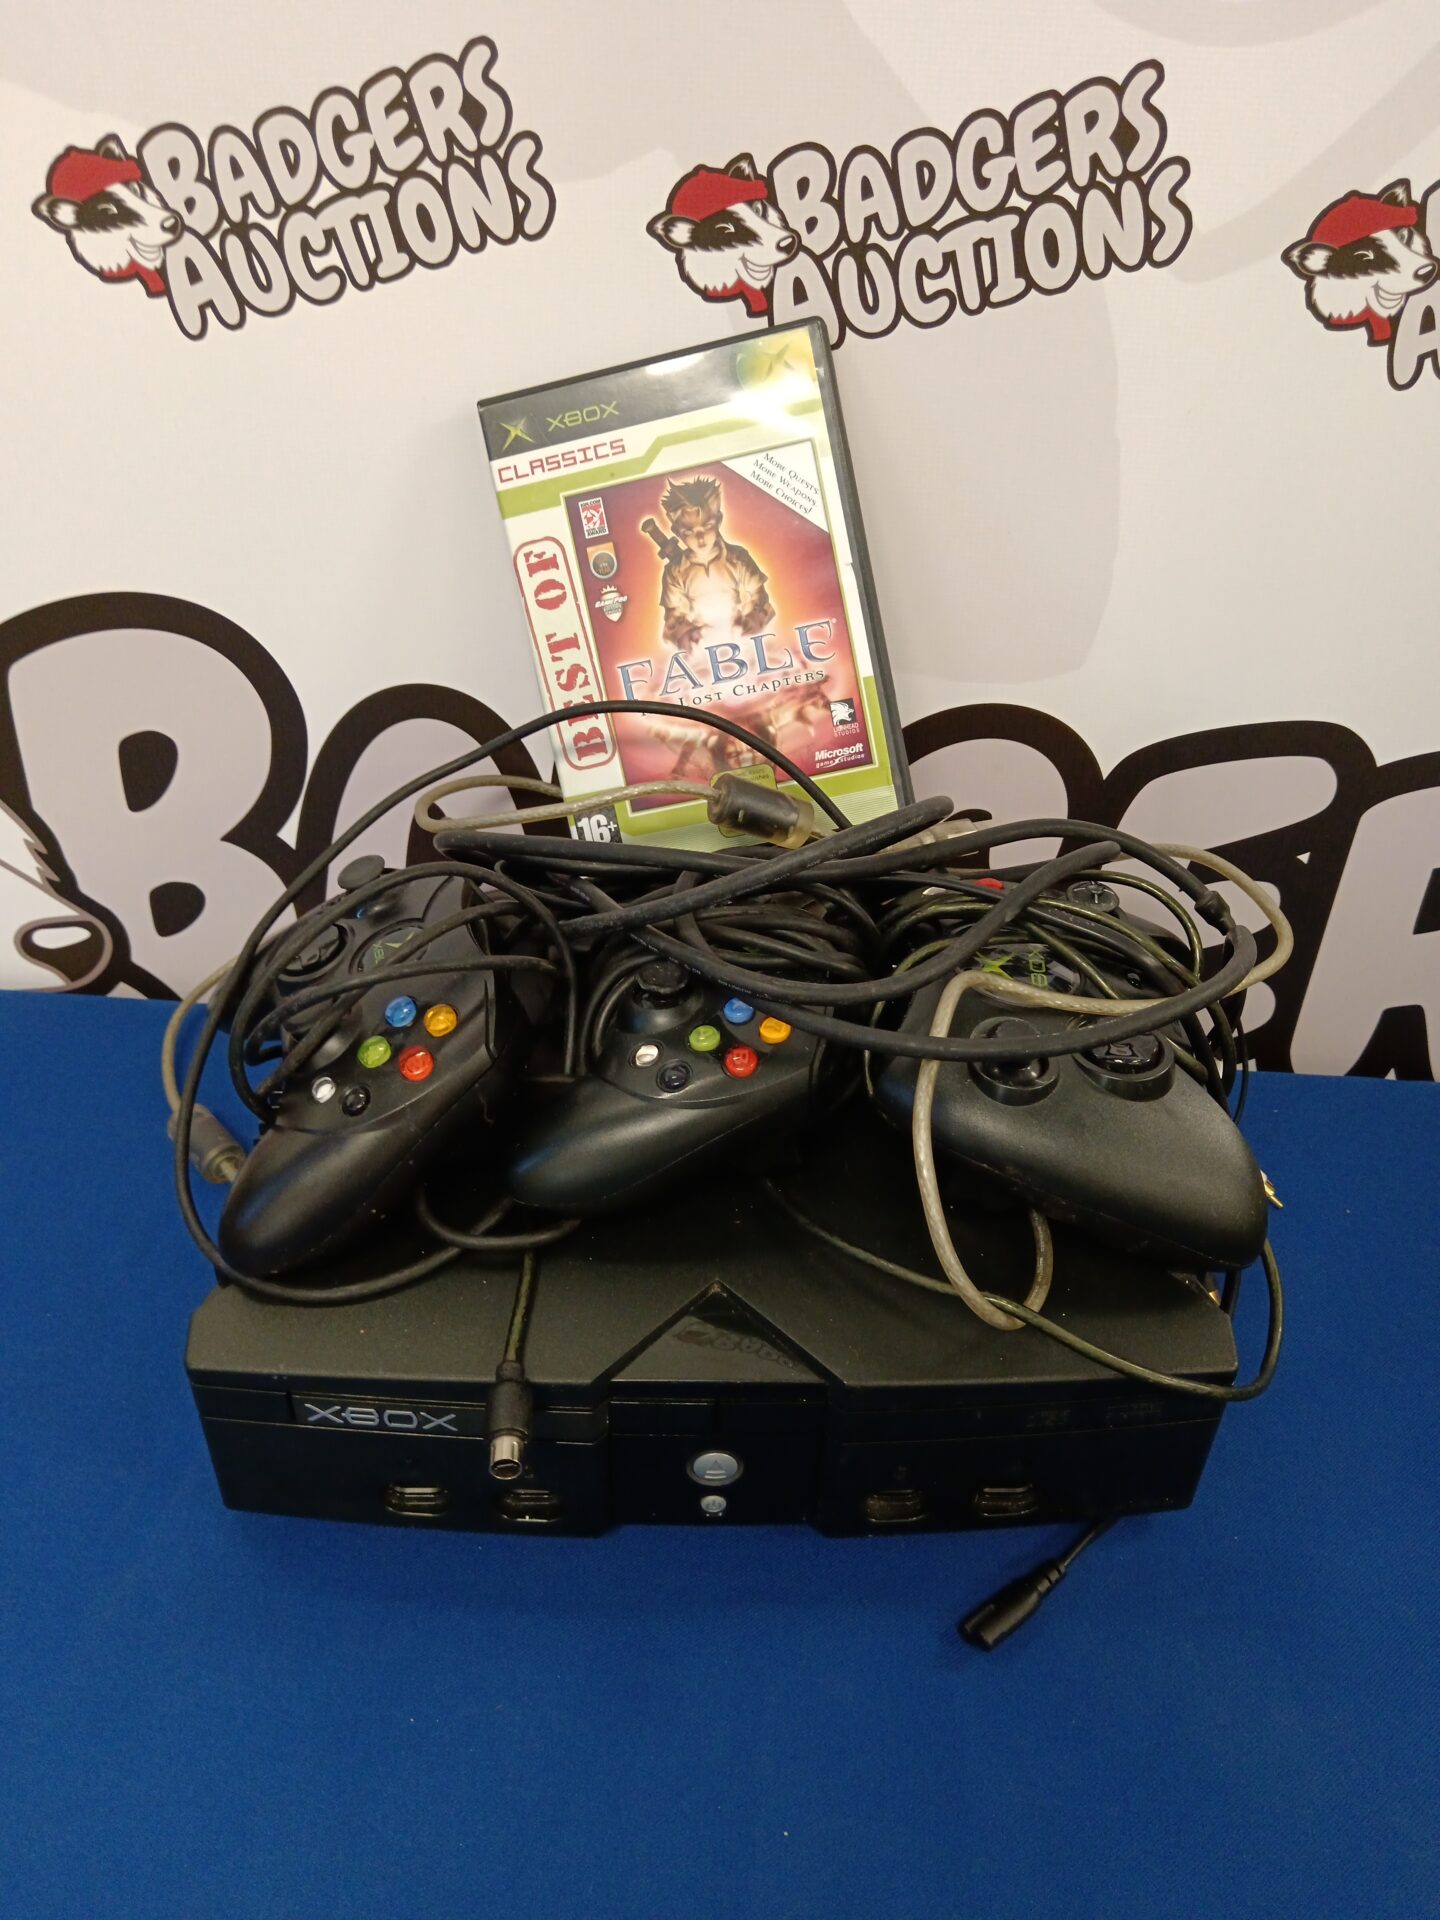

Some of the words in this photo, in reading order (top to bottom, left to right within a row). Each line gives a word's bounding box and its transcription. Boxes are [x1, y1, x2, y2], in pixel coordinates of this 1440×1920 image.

[138, 35, 513, 239] BADGERS
[767, 59, 1169, 258] BADGERS
[165, 130, 557, 341] AUCTIONS
[768, 155, 1192, 350] AUCTIONS
[546, 401, 620, 432] XBOX
[497, 438, 627, 484] CLASSICS
[523, 550, 568, 611] OF
[617, 620, 836, 702] FABLE
[815, 743, 863, 760] Microsoft
[304, 1403, 459, 1432] XBOX
